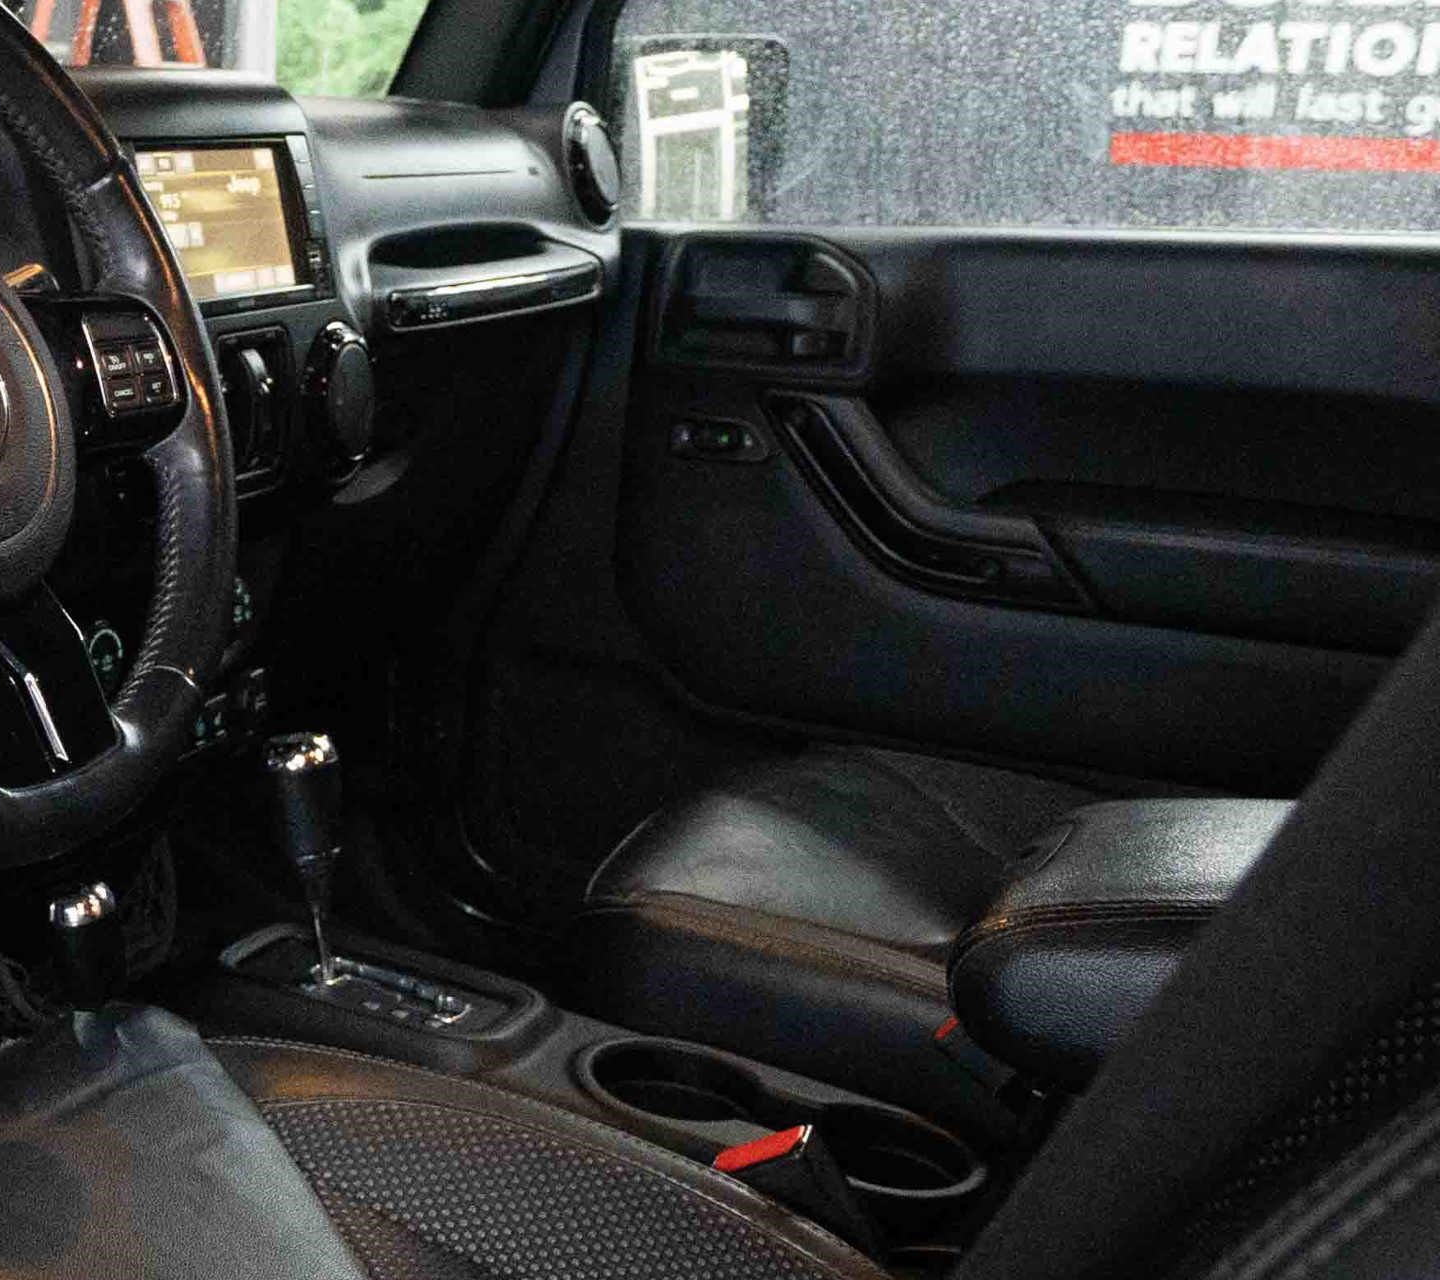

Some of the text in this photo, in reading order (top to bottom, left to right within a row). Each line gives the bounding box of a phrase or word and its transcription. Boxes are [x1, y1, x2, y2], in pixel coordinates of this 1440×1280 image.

[1111, 86, 1197, 125] that
[1214, 88, 1276, 127] will
[1299, 89, 1393, 130] last
